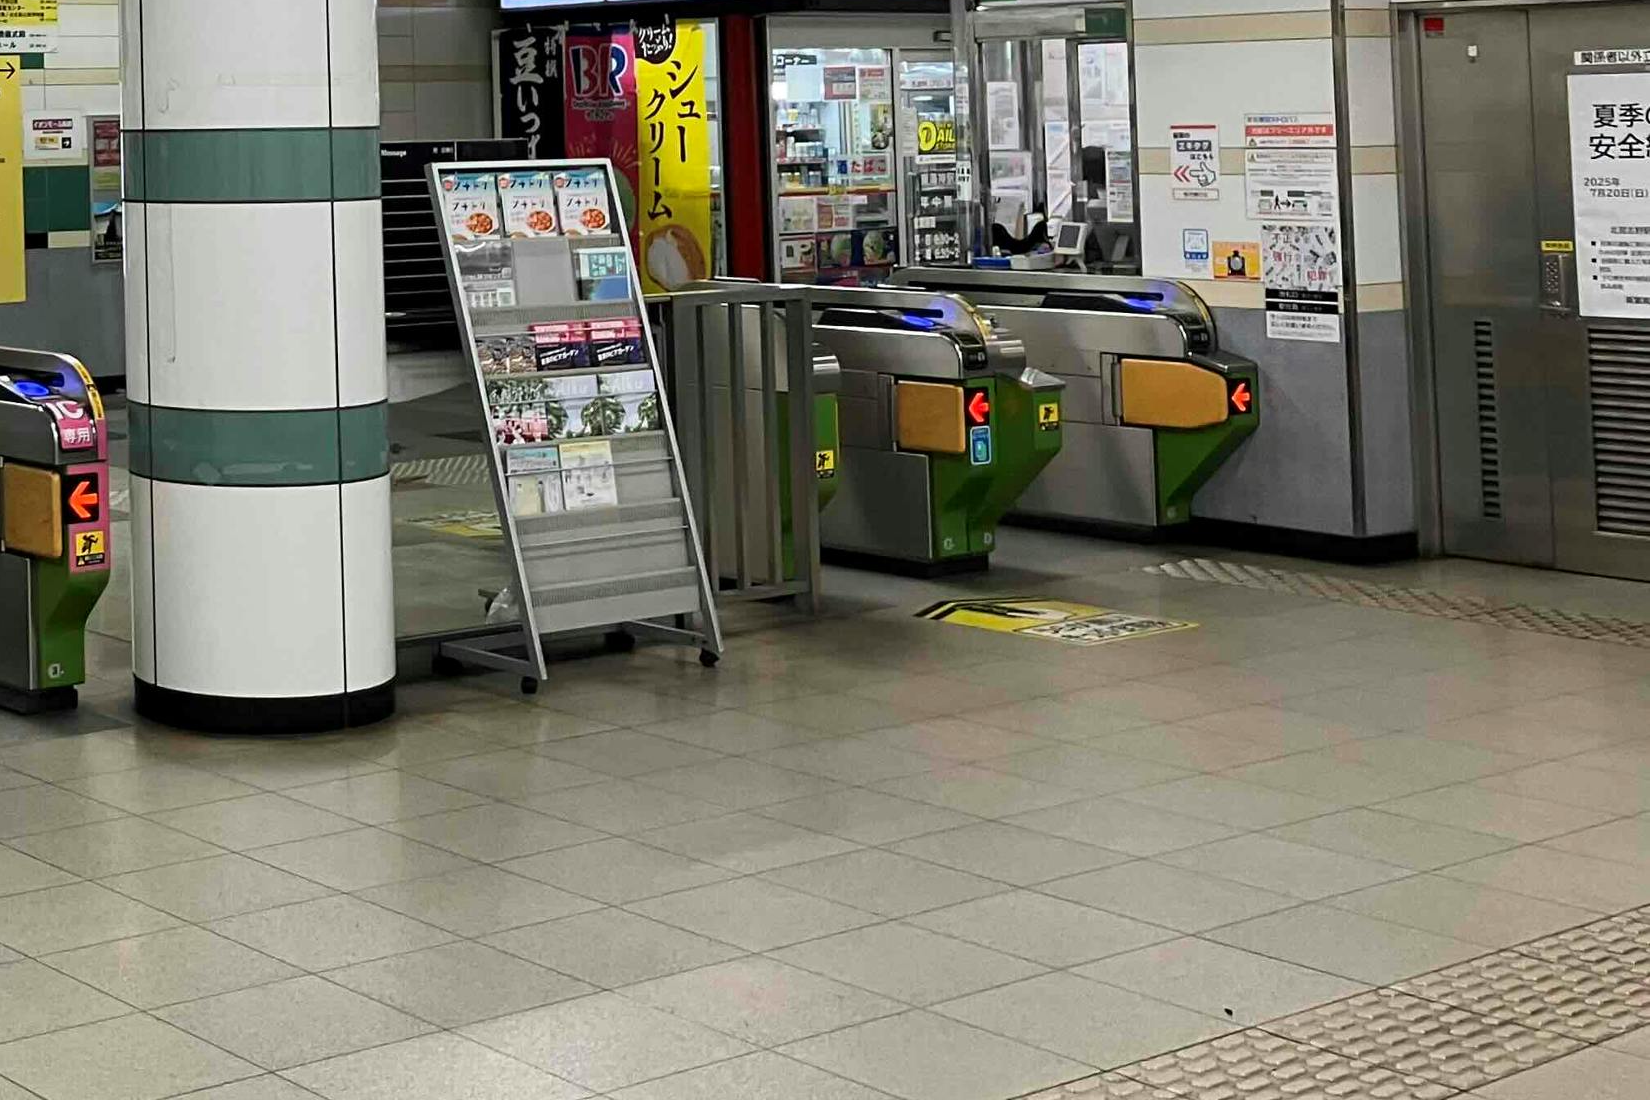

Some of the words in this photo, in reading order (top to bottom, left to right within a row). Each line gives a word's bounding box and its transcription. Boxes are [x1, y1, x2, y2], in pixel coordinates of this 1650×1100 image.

[667, 60, 701, 163] シュー
[1592, 102, 1650, 129] 夏季
[918, 121, 956, 152] DAIL
[1589, 133, 1650, 160] 安全
[644, 87, 673, 220] クリーム
[1583, 177, 1620, 187] 2025年
[63, 427, 91, 443] 専用
